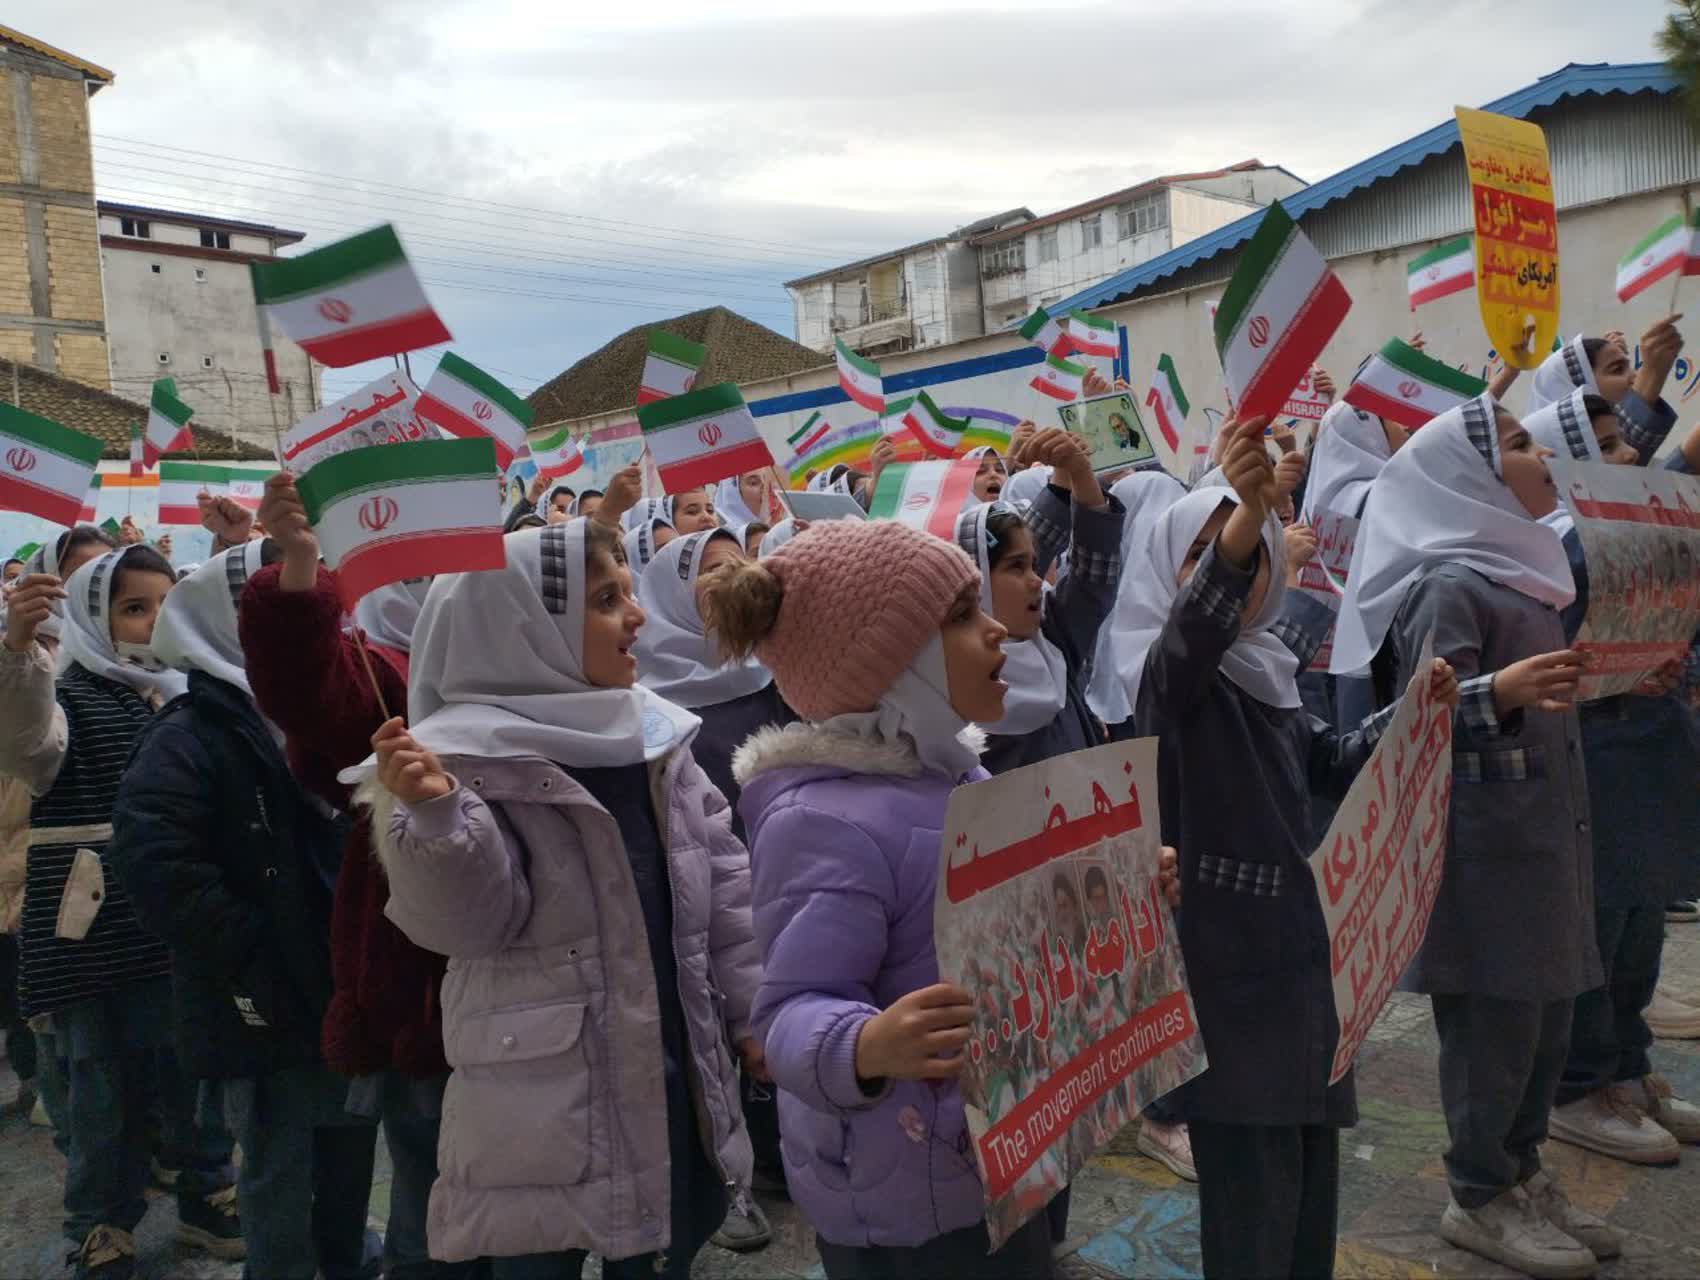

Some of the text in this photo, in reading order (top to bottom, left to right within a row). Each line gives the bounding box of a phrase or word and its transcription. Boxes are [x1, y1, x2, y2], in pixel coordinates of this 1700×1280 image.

[1478, 191, 1556, 254] رمز افول
[1517, 259, 1557, 290] آمریکای
[283, 378, 407, 462] نهضت
[947, 760, 1142, 905] نهضت
[1322, 750, 1387, 907] آمریکا
[1085, 878, 1166, 978] ادامه
[1333, 856, 1391, 960] DOWN
[987, 1007, 1185, 1188] The movement continues
